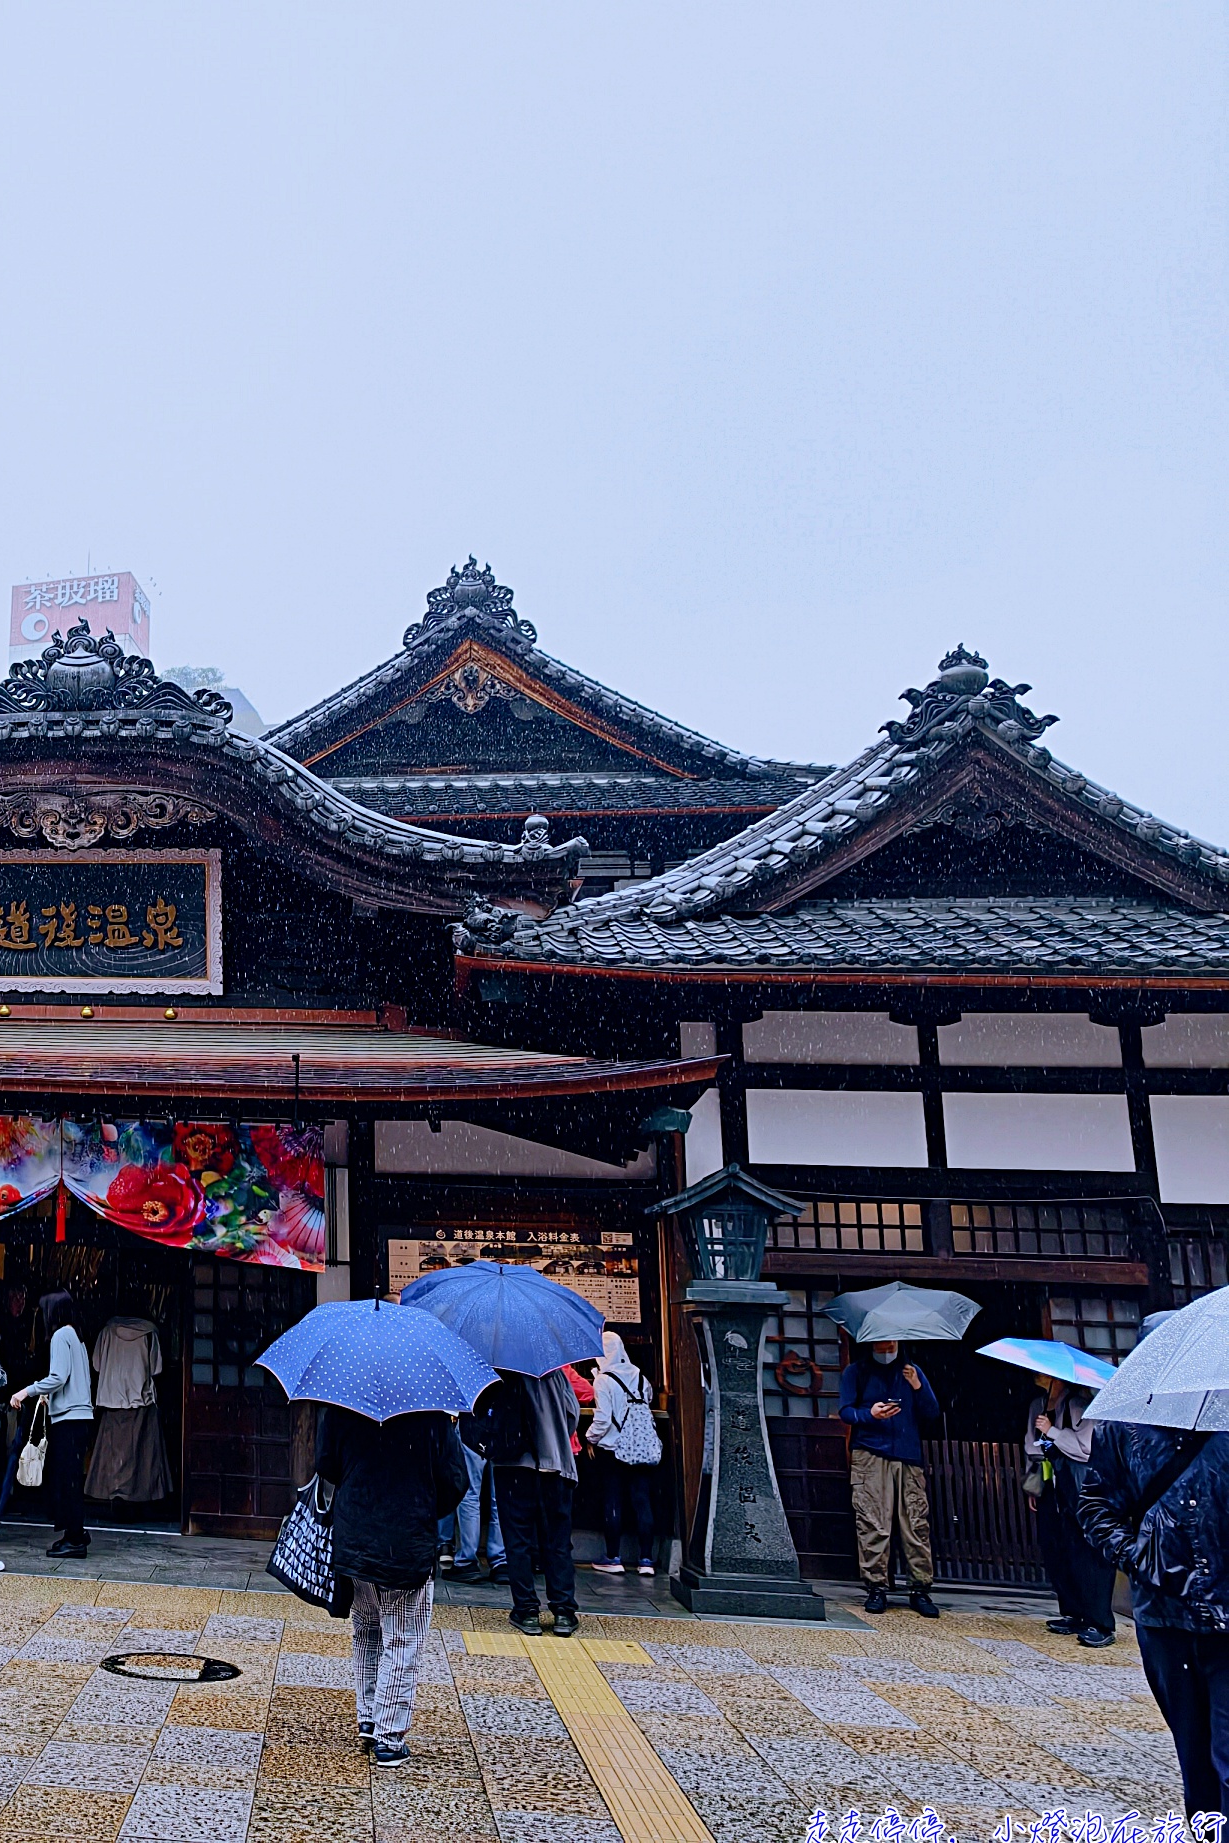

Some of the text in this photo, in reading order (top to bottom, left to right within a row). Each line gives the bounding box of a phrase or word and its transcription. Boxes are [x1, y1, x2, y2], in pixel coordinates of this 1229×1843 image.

[22, 576, 119, 610] 茶玻瑠
[453, 1229, 581, 1243] 道後温泉本館 入浴料金表
